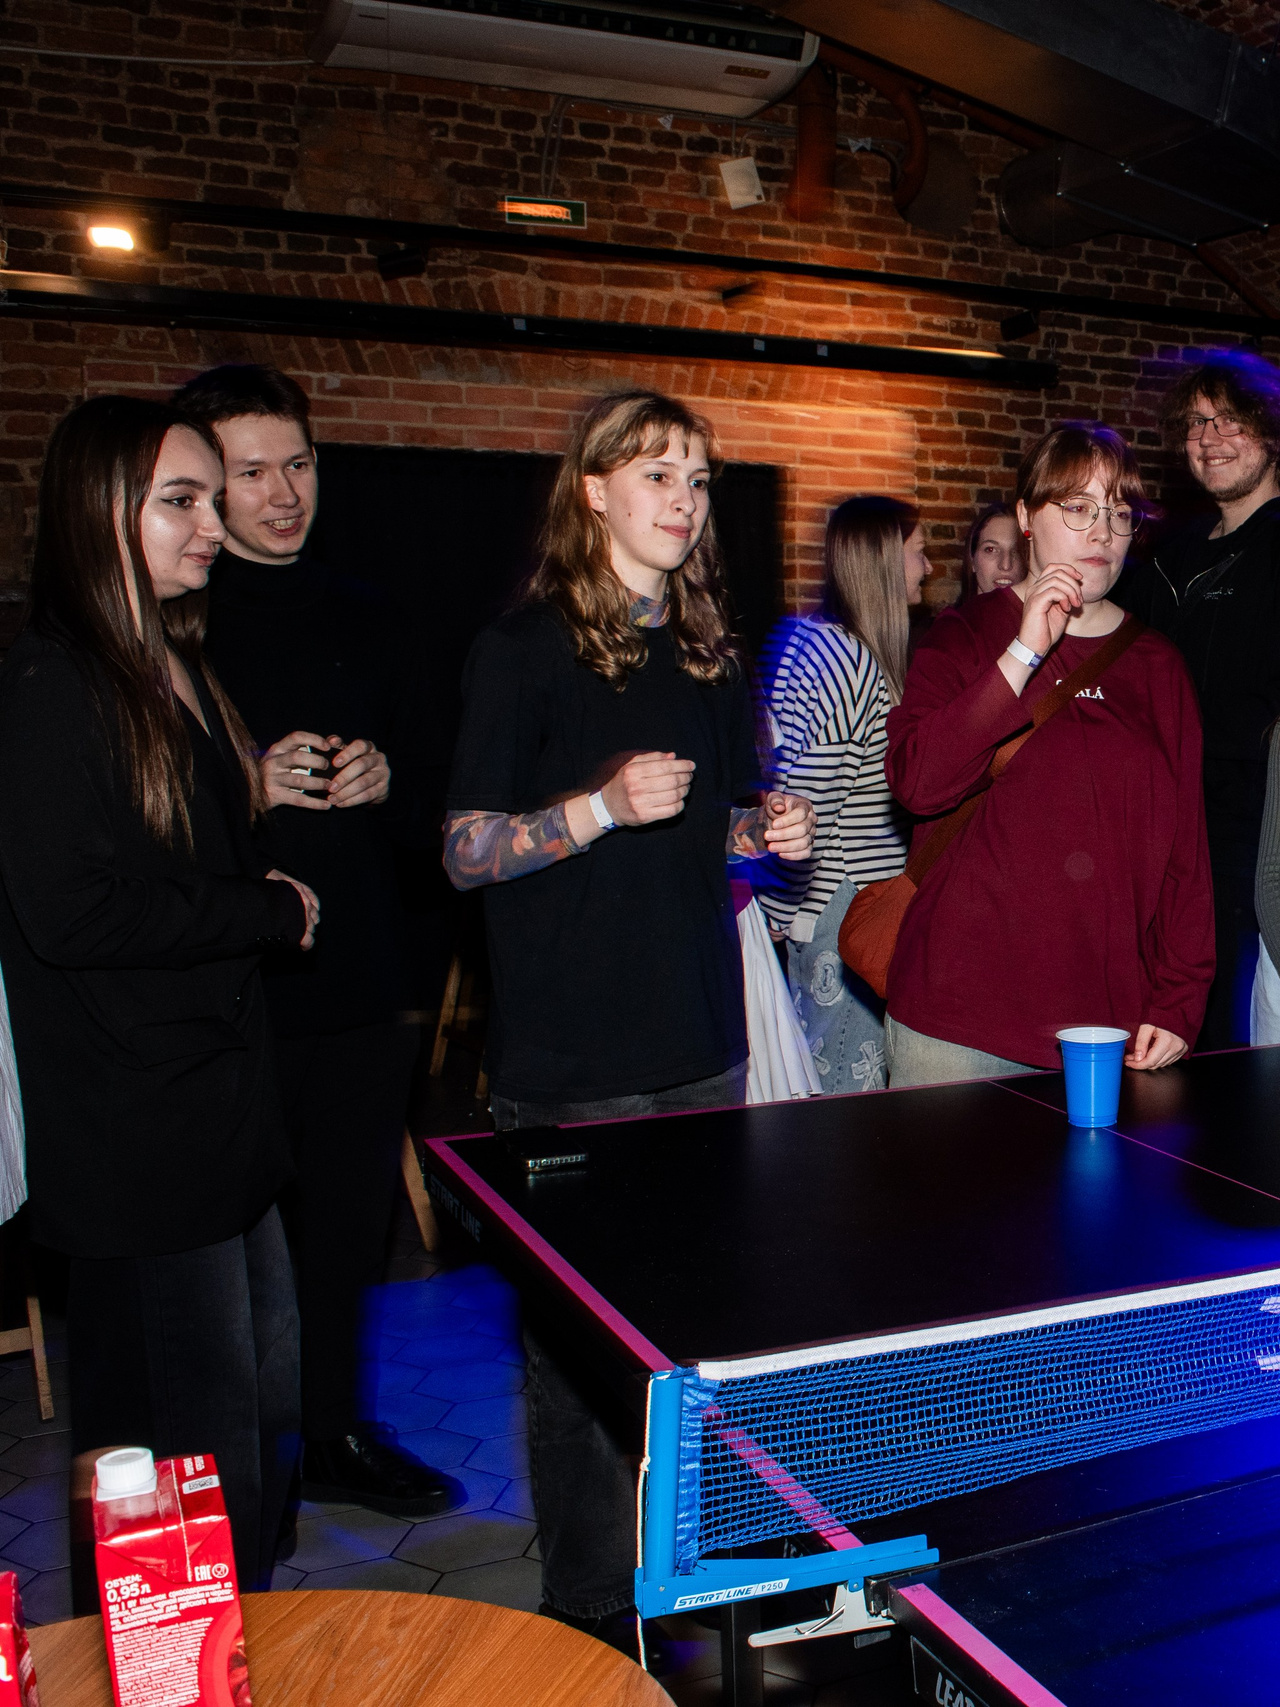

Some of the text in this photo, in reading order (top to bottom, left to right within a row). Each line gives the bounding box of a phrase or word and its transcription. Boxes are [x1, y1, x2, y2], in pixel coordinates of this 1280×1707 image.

[106, 1583, 140, 1603] 0,95
[677, 1581, 784, 1607] START LINE P250
